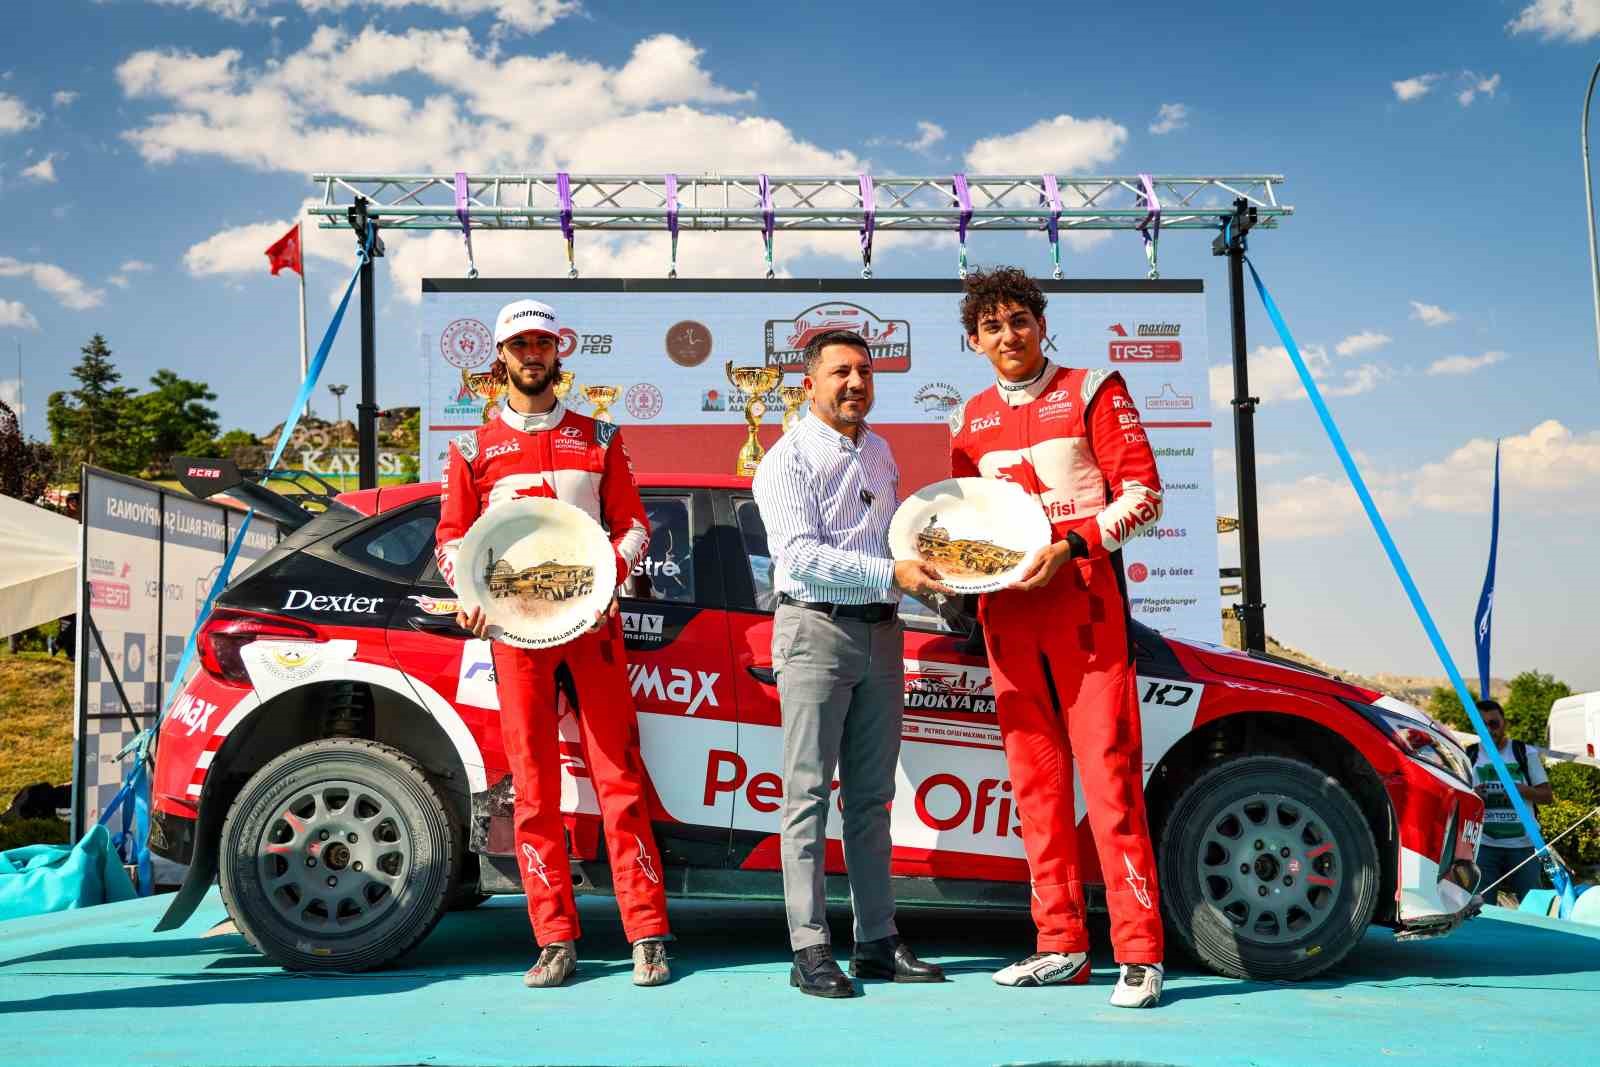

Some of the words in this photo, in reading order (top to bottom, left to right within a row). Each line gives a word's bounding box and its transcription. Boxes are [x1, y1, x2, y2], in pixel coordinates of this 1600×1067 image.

[581, 334, 613, 344] TOS
[580, 345, 612, 354] FED
[1111, 345, 1153, 359] TRS
[282, 589, 385, 614] Dexter
[903, 693, 971, 710] ADOKYA
